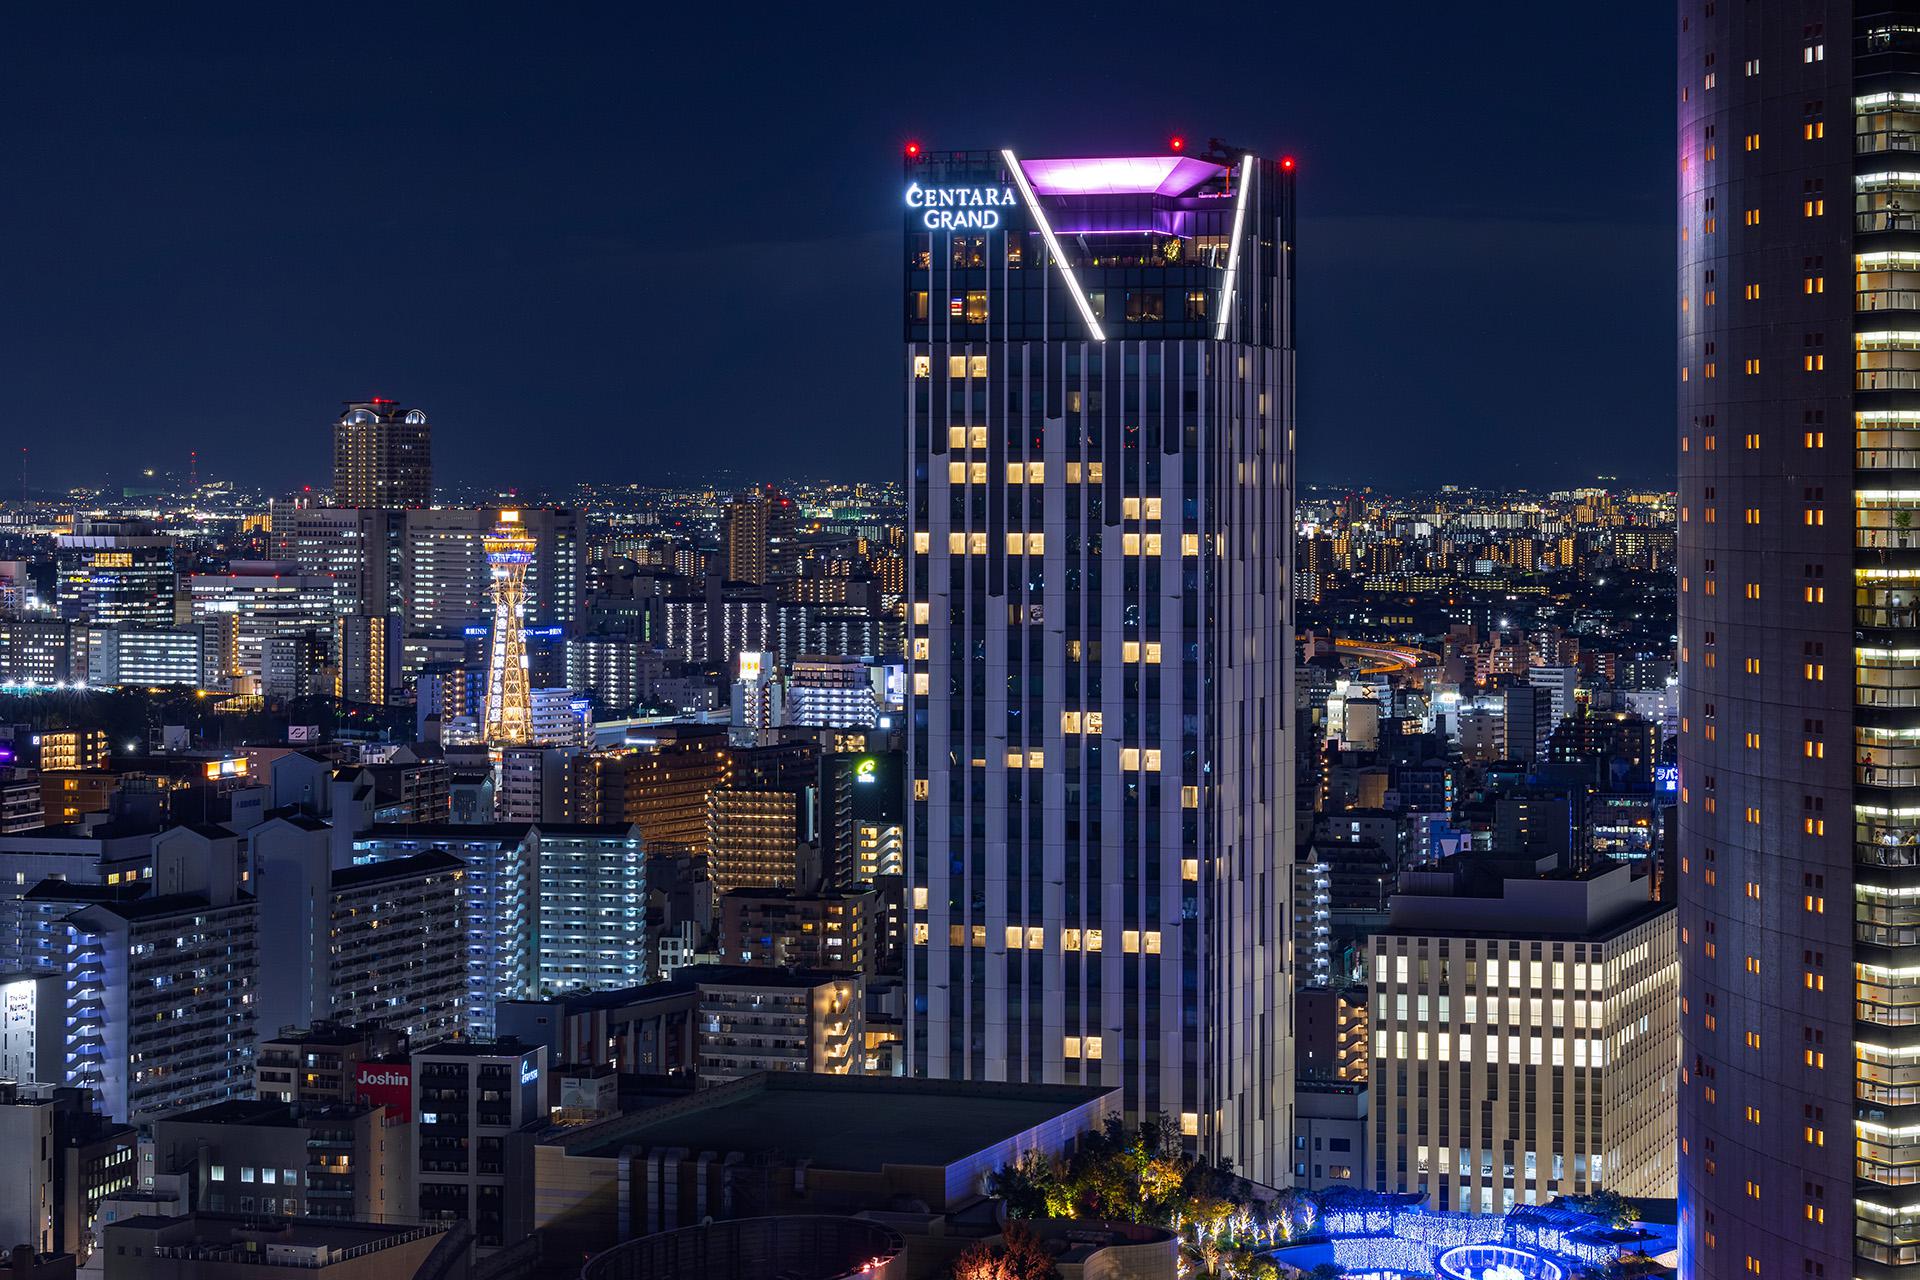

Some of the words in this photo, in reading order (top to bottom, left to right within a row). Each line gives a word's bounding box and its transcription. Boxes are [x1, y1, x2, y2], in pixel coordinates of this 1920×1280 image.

[906, 182, 1017, 208] CENTARA
[923, 209, 999, 231] GRAND
[357, 1070, 409, 1086] Joshin
